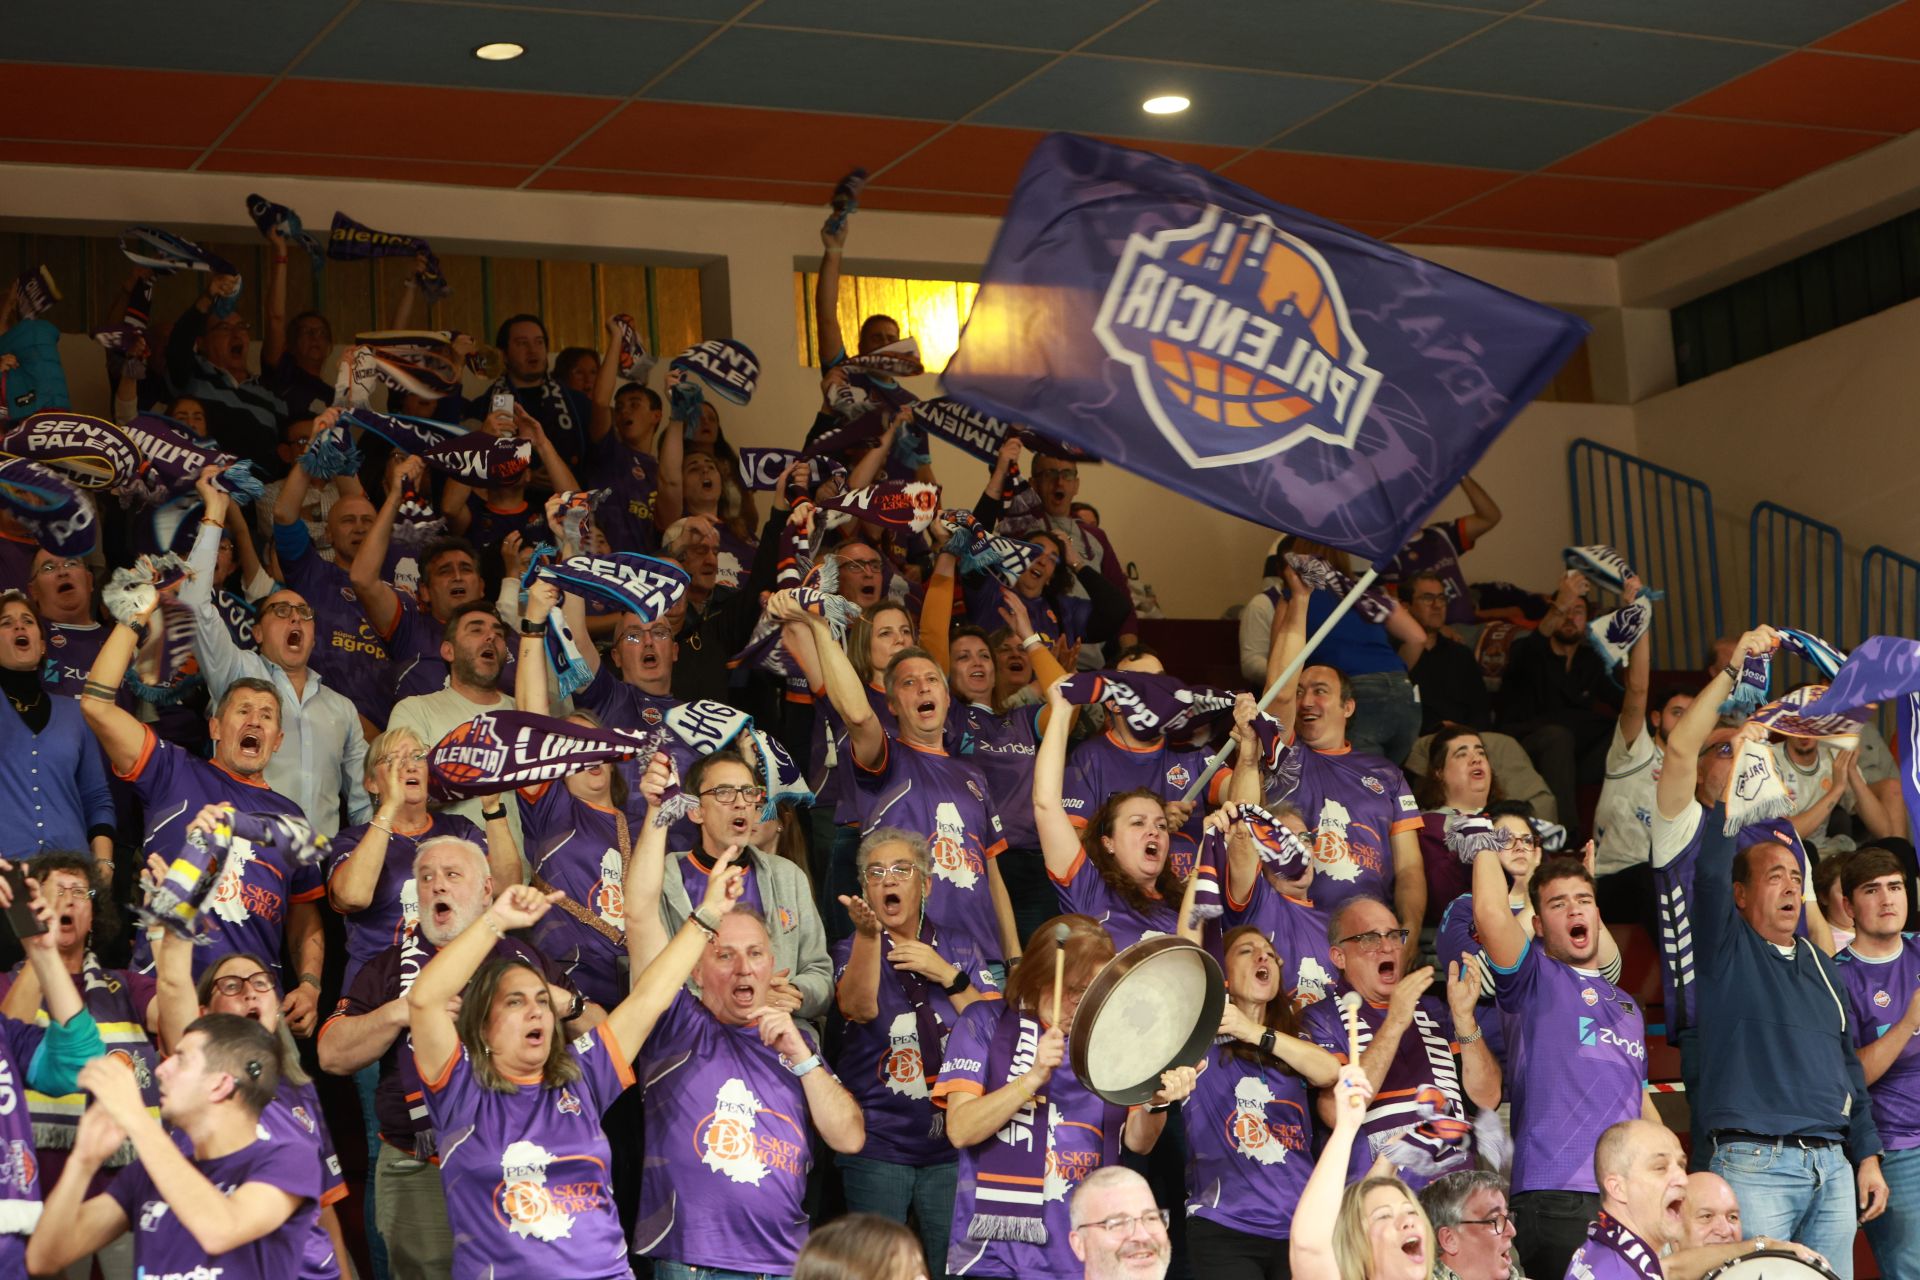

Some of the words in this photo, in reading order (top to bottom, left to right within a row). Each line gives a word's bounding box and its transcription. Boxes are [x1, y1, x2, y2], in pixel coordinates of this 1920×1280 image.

[701, 340, 759, 377] ENT
[434, 746, 500, 774] ALENCIA
[938, 820, 963, 835] PEÑA
[1299, 975, 1328, 991] PEÑA
[719, 1099, 756, 1117] PEÑA
[1237, 1098, 1265, 1111] PEÑA
[507, 1162, 546, 1178] PEÑA
